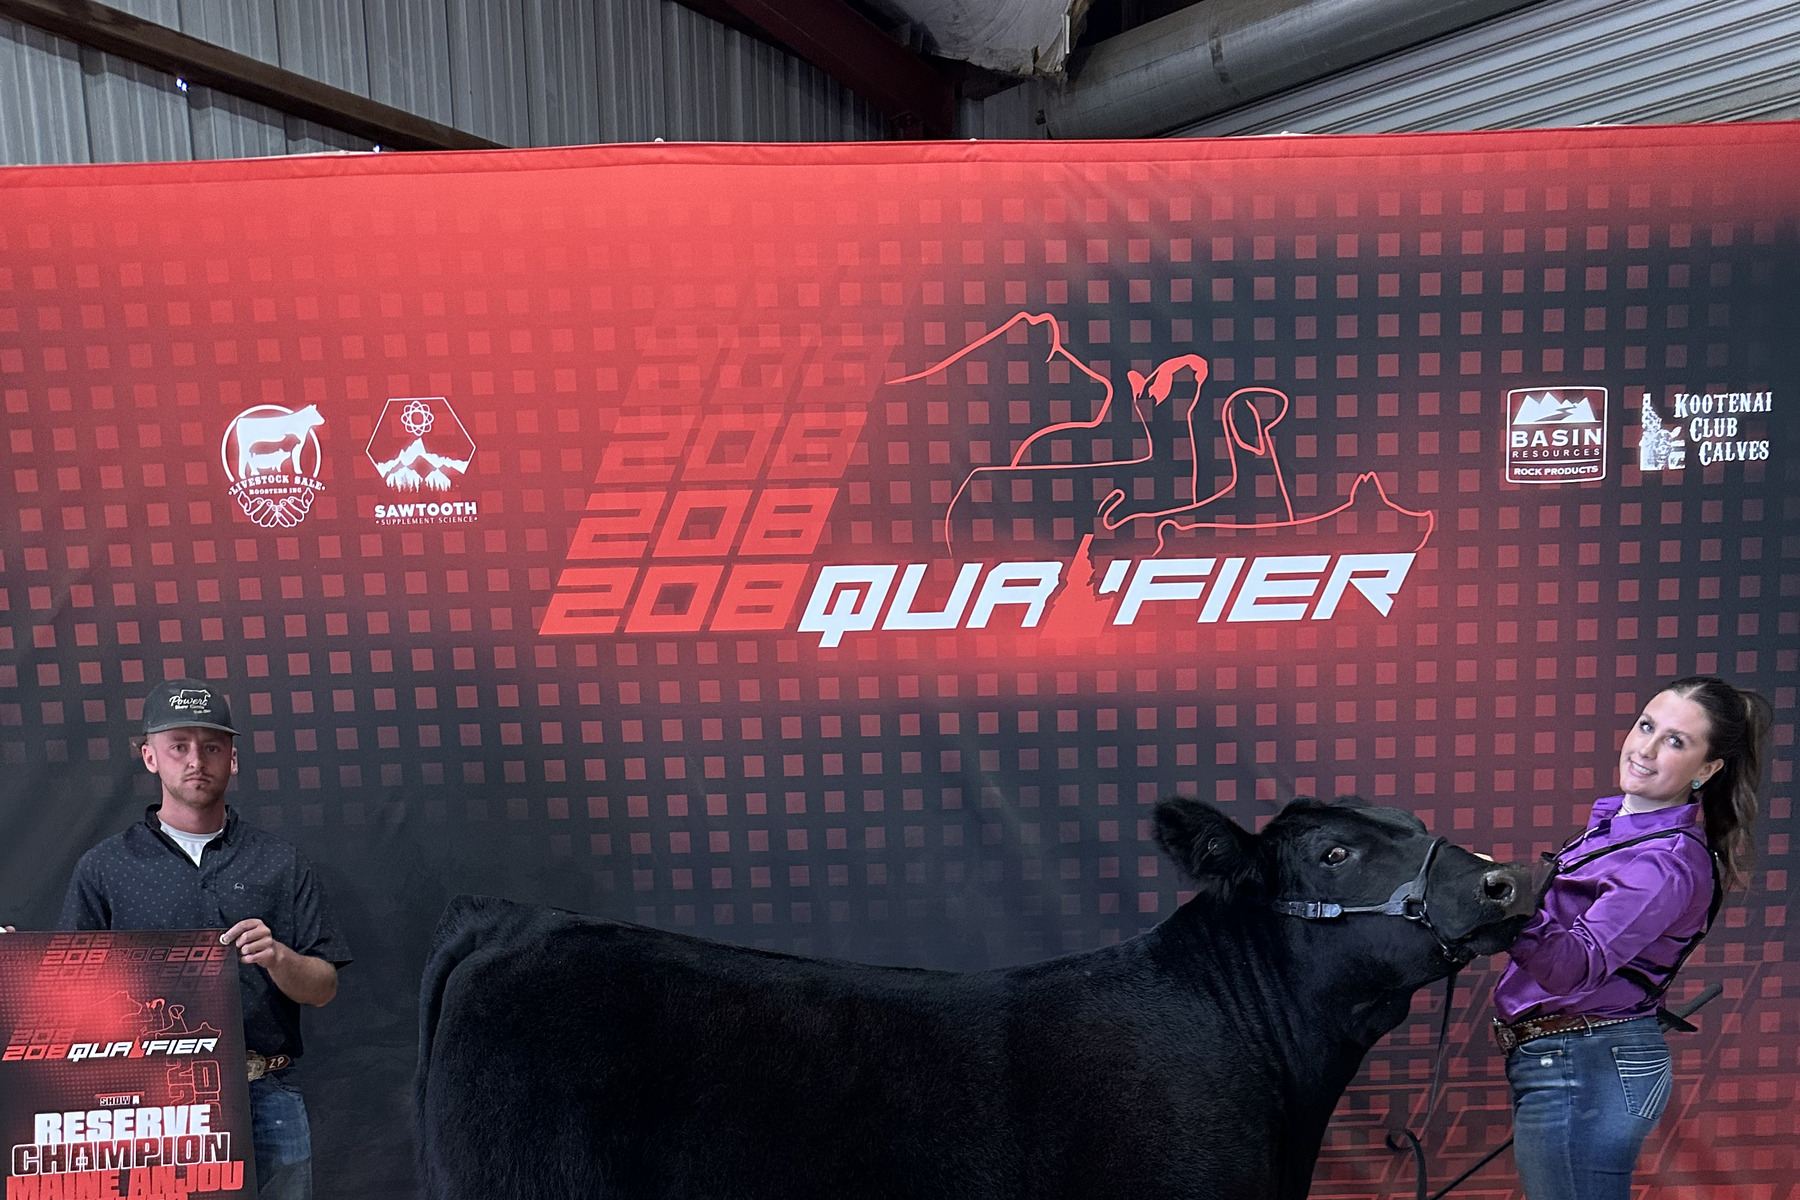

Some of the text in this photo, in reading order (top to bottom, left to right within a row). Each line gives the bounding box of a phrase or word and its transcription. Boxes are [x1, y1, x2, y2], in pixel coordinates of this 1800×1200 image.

[1673, 392, 1772, 418] KOOTENAI
[1510, 428, 1602, 448] BASIN
[1689, 417, 1738, 442] CLUB
[594, 412, 868, 483] 208
[1512, 448, 1601, 458] RESOURCES
[1699, 440, 1770, 466] CALVES
[1513, 465, 1599, 476] ROCK PRODUCTS
[231, 474, 324, 495] LIVESTOCK SALE
[374, 501, 477, 518] SAWTOOTH
[381, 516, 474, 526] SUPPLEMENT SCIENCE
[567, 488, 839, 559] 208
[538, 563, 810, 636] 208
[2, 1044, 70, 1060] 208
[100, 1095, 140, 1105] SHOW A
[35, 1104, 211, 1145] RESERVE
[12, 1132, 231, 1177] CHAMPION
[128, 1161, 244, 1200] ANJOU
